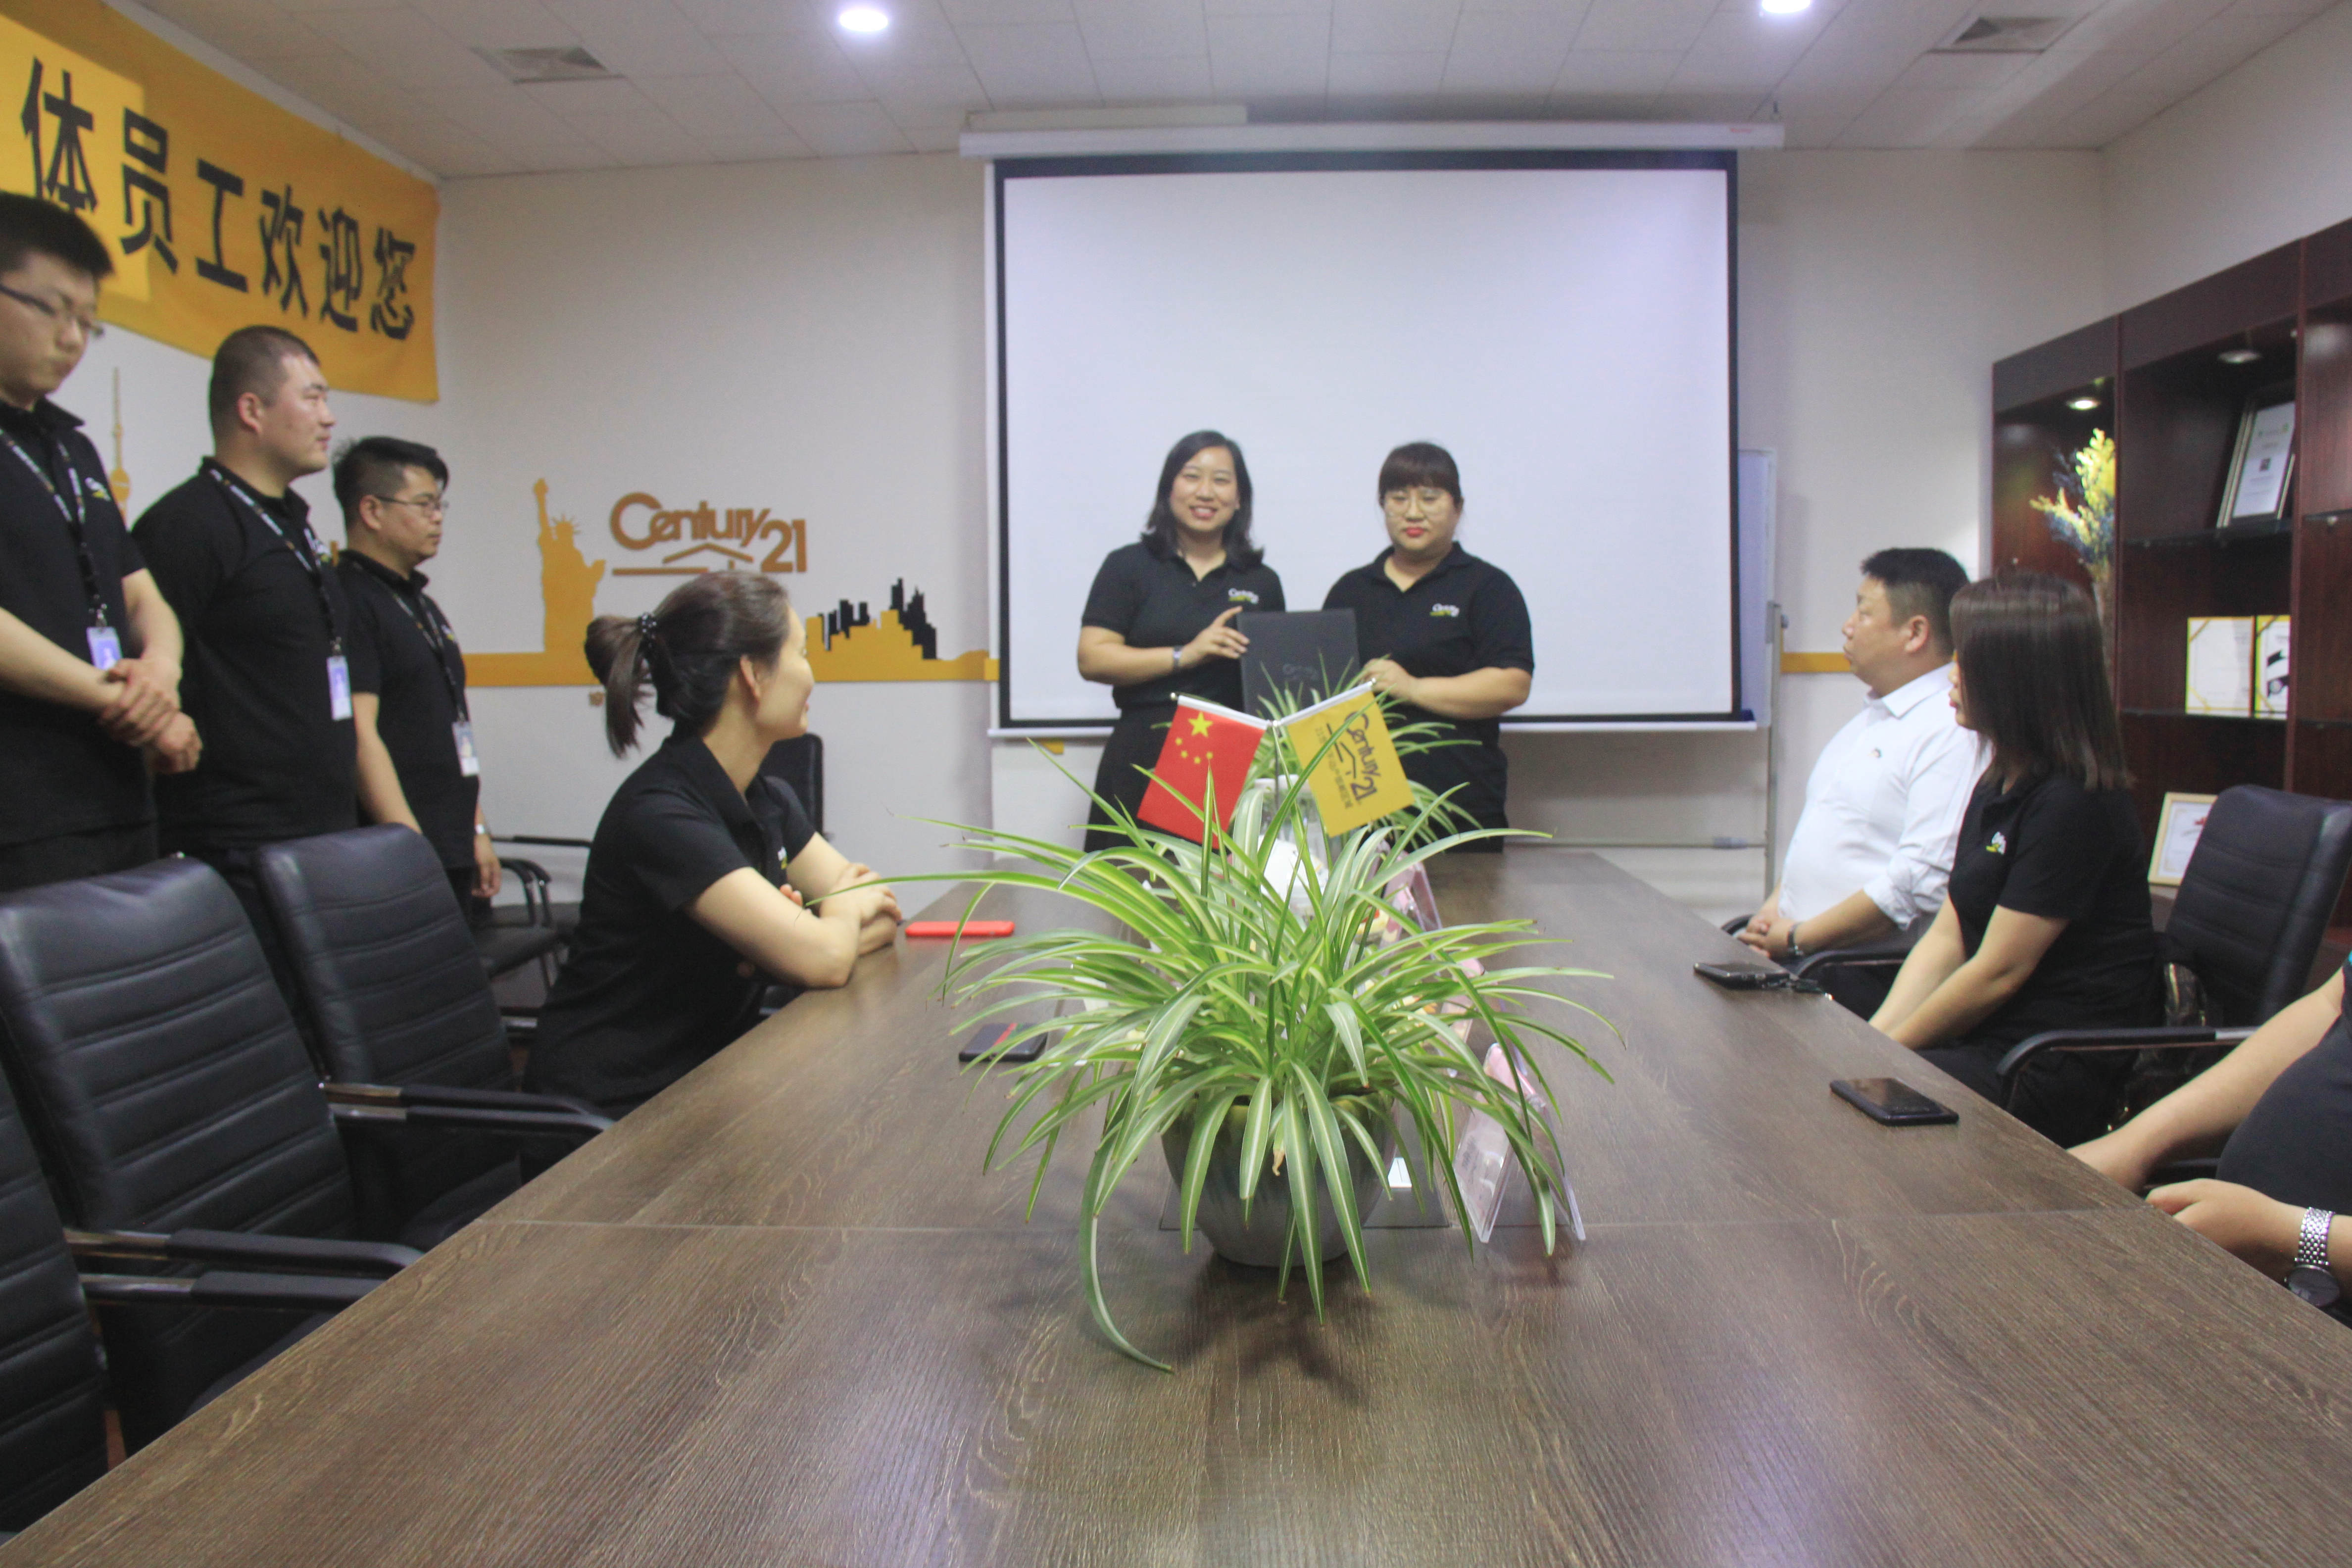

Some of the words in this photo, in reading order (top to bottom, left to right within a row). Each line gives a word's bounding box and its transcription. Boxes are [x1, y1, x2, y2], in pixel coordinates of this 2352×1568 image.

[21, 56, 416, 341] 体员工欢迎您
